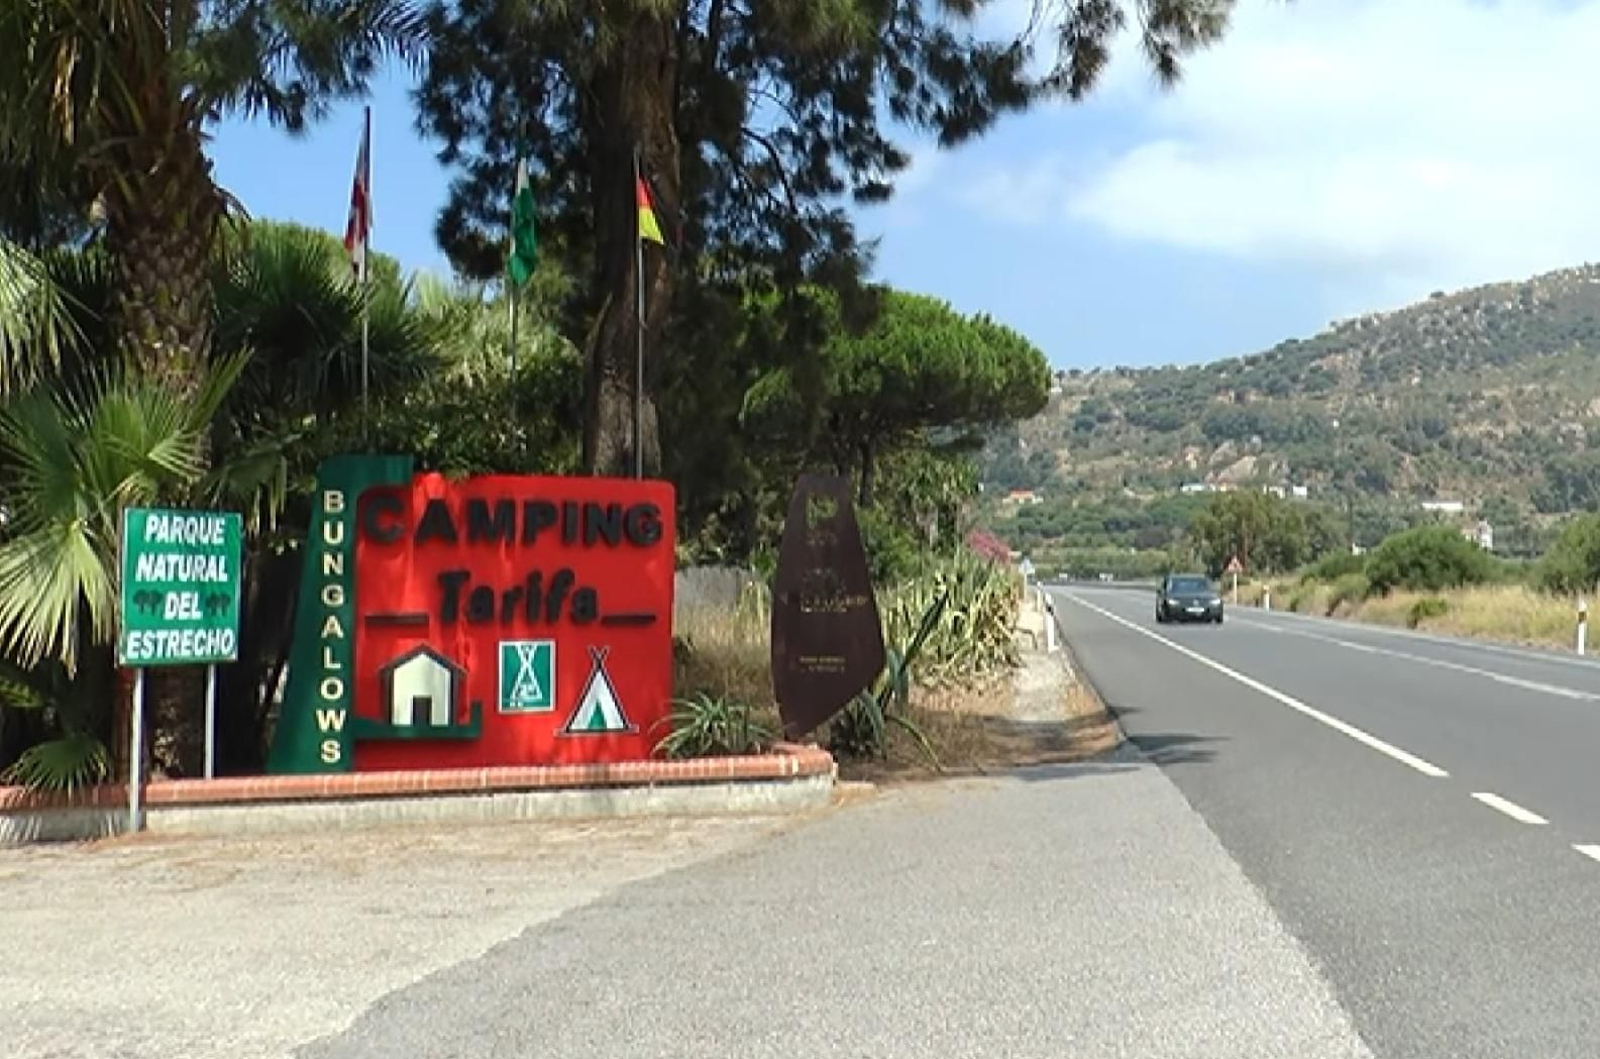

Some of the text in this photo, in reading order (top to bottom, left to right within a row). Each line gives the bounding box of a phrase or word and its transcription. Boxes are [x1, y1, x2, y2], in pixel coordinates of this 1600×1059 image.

[145, 514, 226, 547] PARQUE
[363, 495, 662, 547] CAMPING
[135, 552, 228, 582] NATURAL
[163, 590, 203, 620] DEL
[437, 568, 599, 625] Tarifa
[316, 490, 346, 763] BUNGALOWS
[126, 627, 236, 660] ESTRECHO
